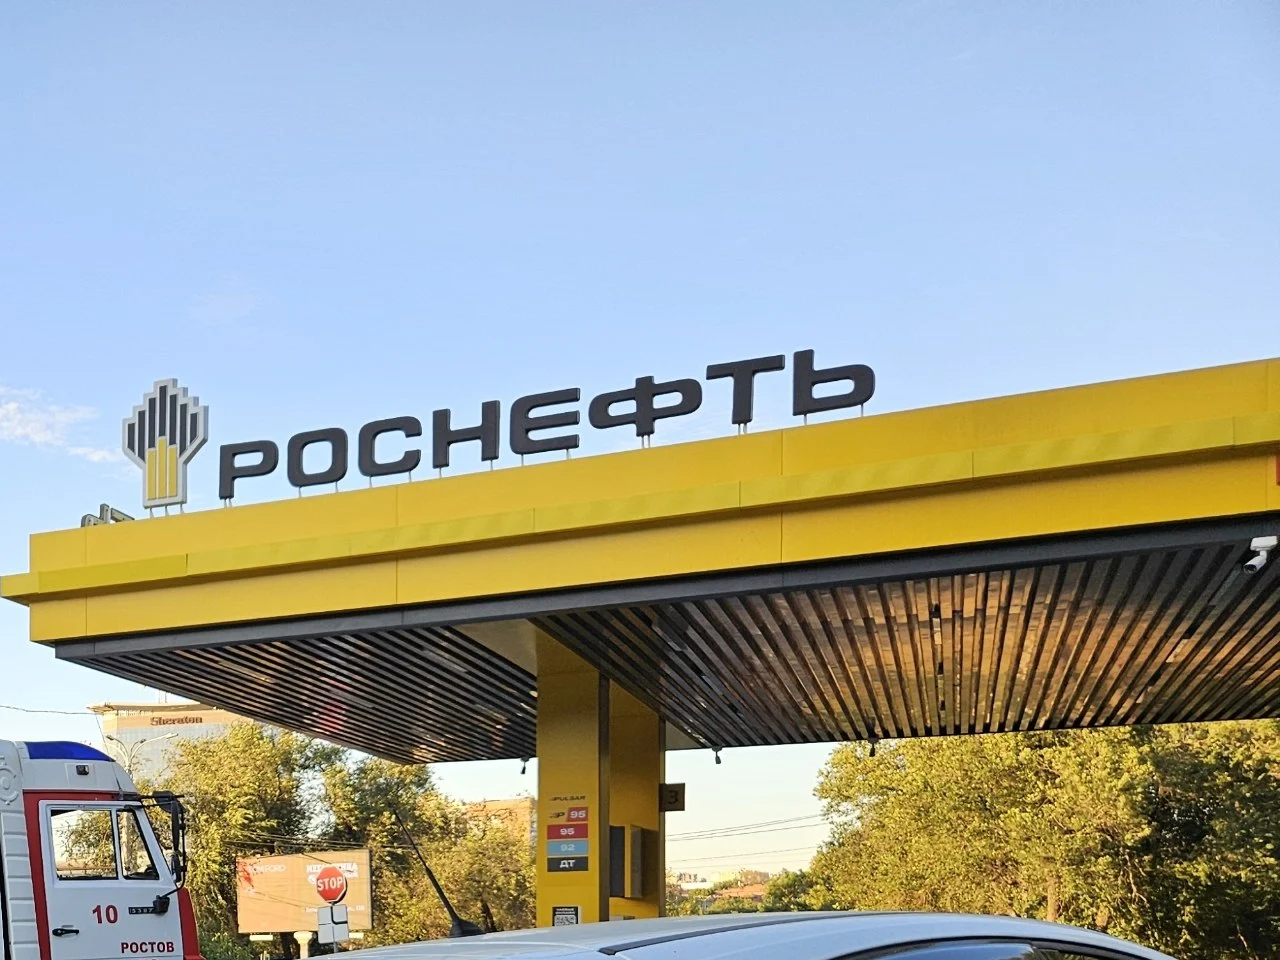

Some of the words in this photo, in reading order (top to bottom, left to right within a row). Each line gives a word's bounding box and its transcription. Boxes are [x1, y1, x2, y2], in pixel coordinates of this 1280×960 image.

[219, 349, 876, 499] РОСНЕФТЬ
[150, 715, 203, 726] Sheraton
[570, 810, 586, 819] 95
[560, 827, 575, 836] 95
[560, 844, 575, 852] 92
[559, 859, 576, 868] ДТ
[317, 876, 344, 891] STOP
[92, 904, 119, 924] 10
[121, 941, 175, 953] РОСТОВ
